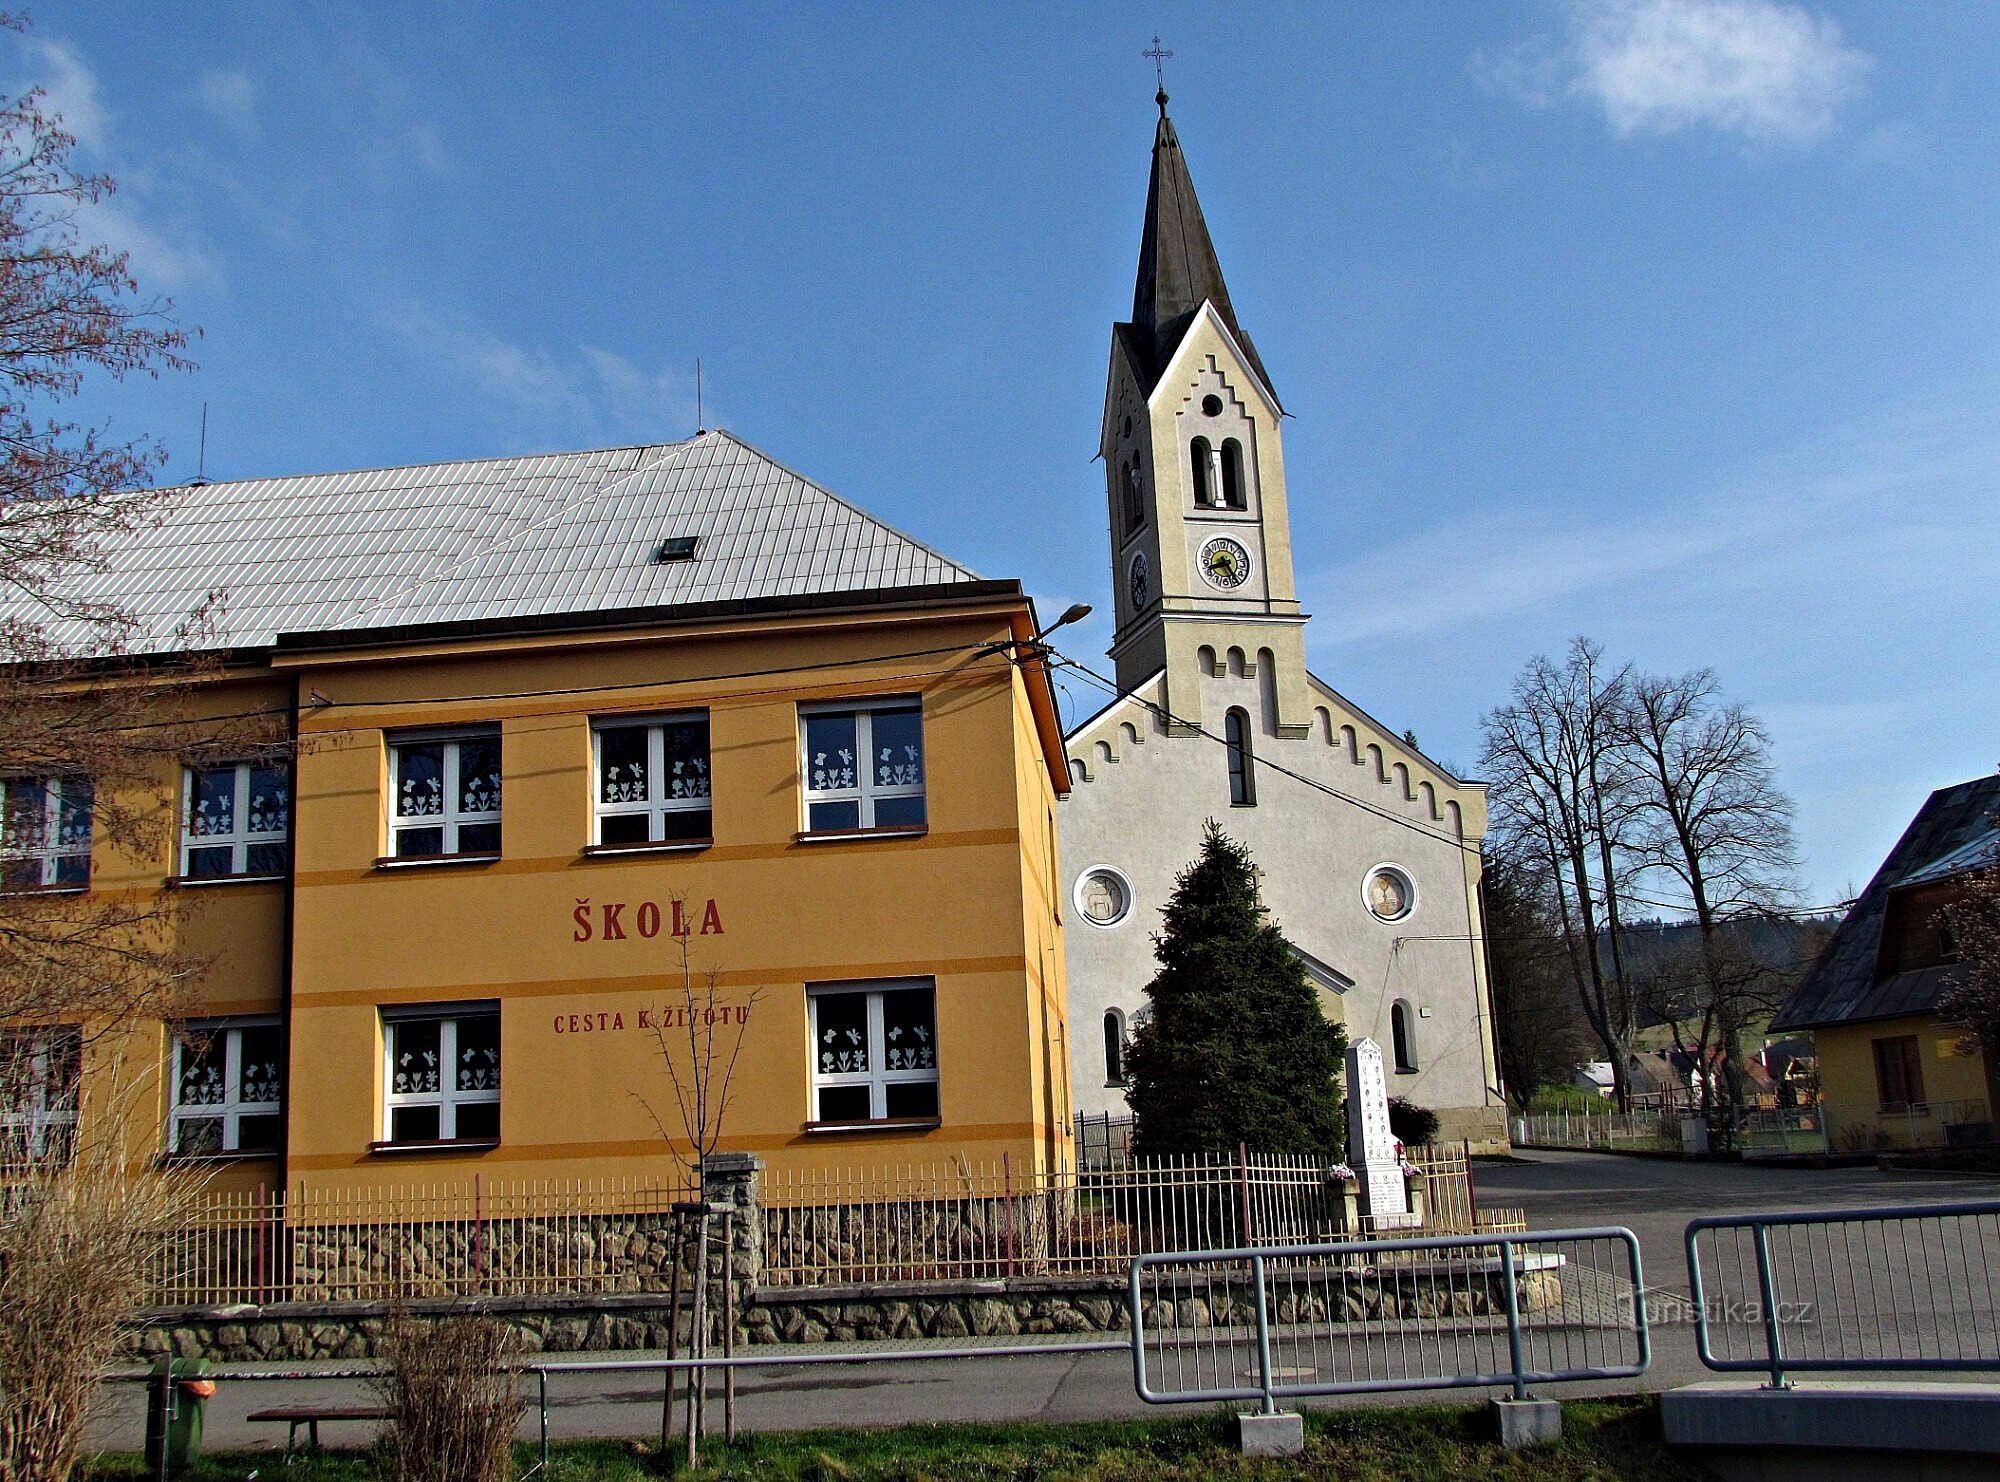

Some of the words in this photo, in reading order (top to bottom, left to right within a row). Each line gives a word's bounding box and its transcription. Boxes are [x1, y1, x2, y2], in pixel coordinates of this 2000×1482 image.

[573, 897, 725, 943] ŠKOLA
[553, 1012, 624, 1034] CESTA
[638, 1010, 650, 1029] K
[663, 1006, 749, 1028] ŽIVOTU
